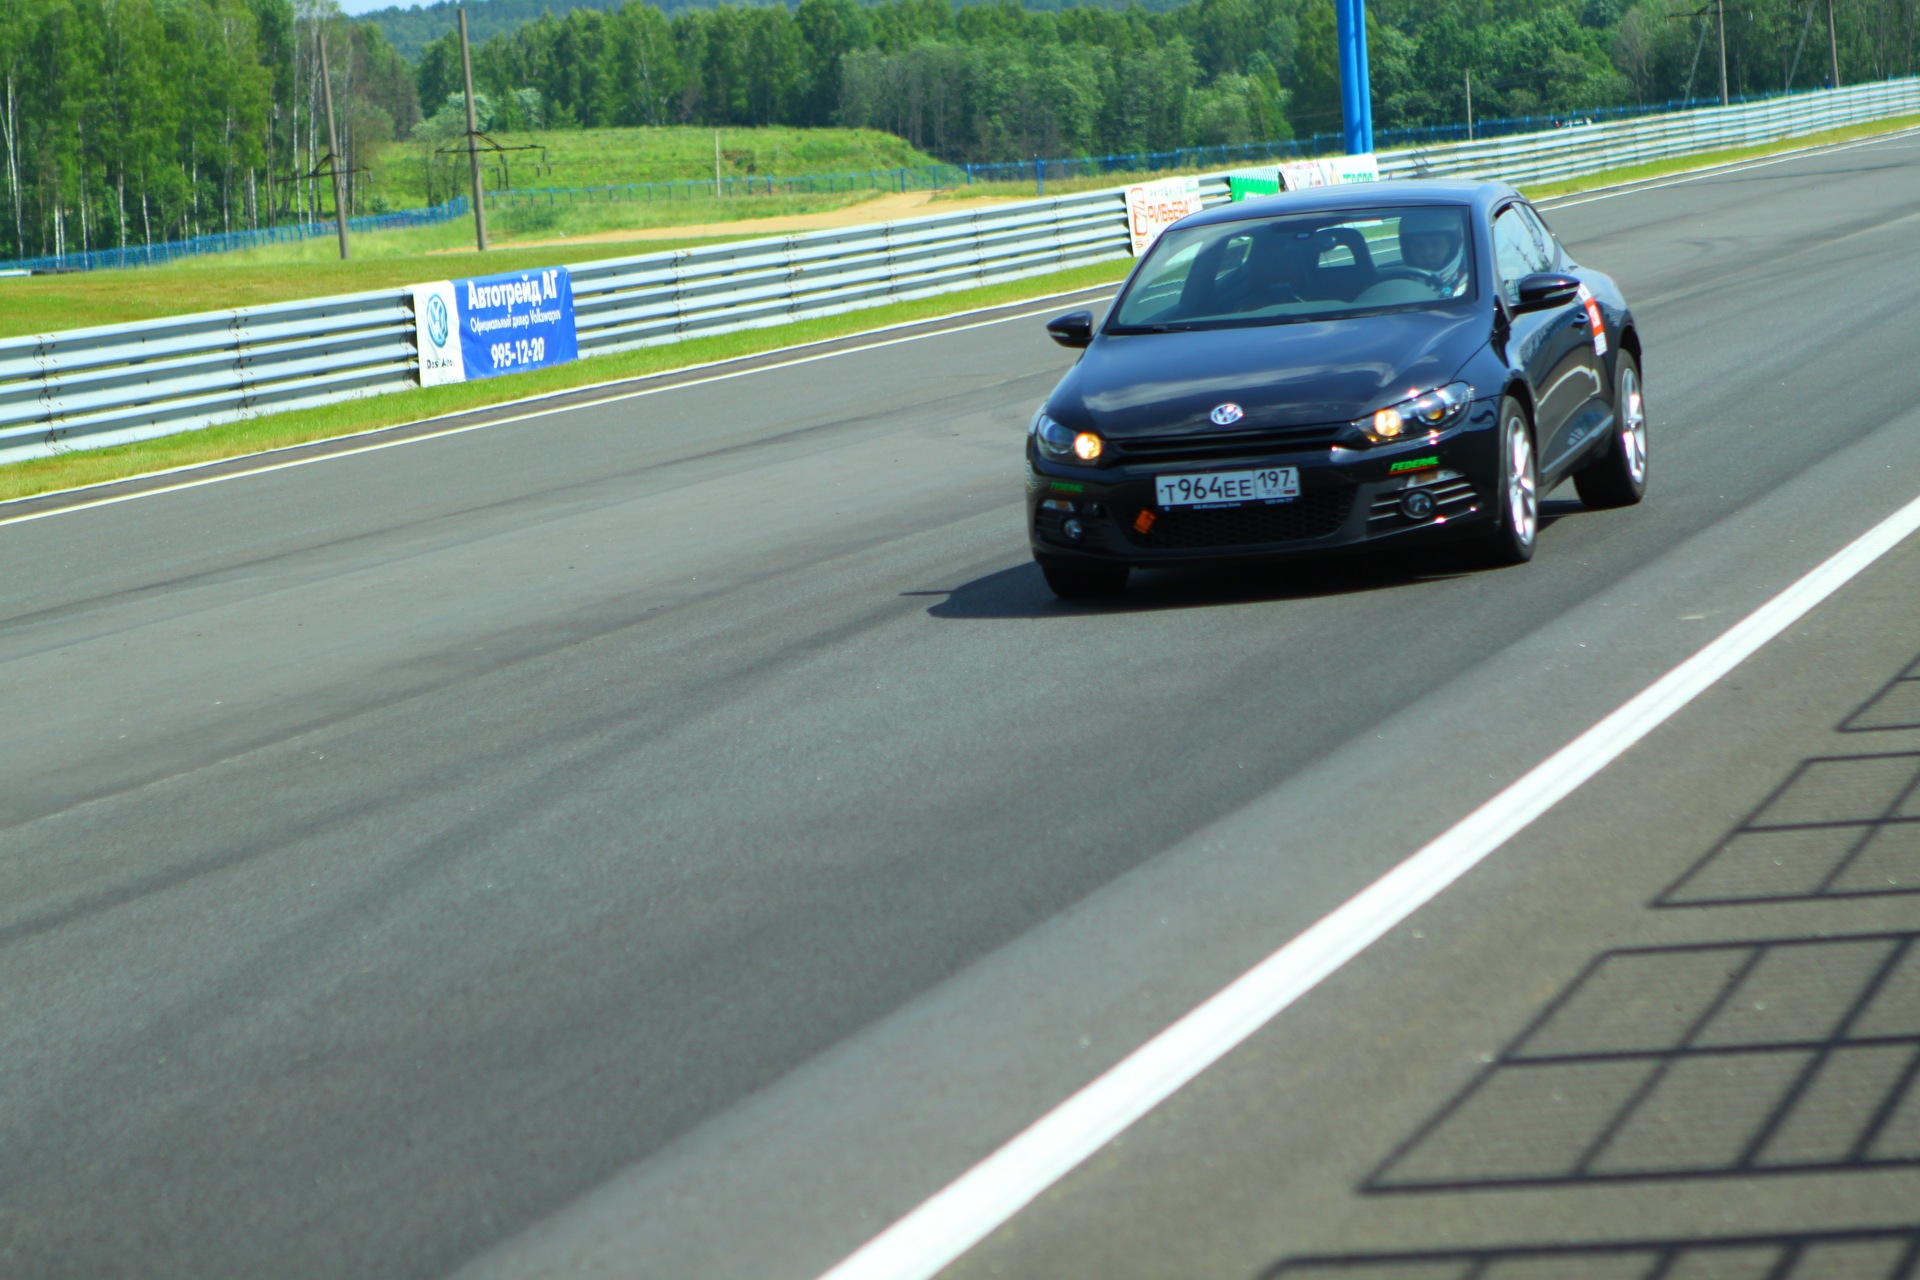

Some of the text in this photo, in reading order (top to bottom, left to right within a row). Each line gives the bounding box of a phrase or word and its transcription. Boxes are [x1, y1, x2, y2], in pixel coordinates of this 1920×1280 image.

[1147, 200, 1189, 223] РИВЬЕРА
[467, 270, 558, 312] Автотрейд АГ
[470, 308, 561, 336] Официальный дилер Volkswagen
[491, 337, 545, 369] 995-12-20
[1389, 456, 1439, 472] FEDERAL
[1164, 470, 1290, 502] T964EE 197
